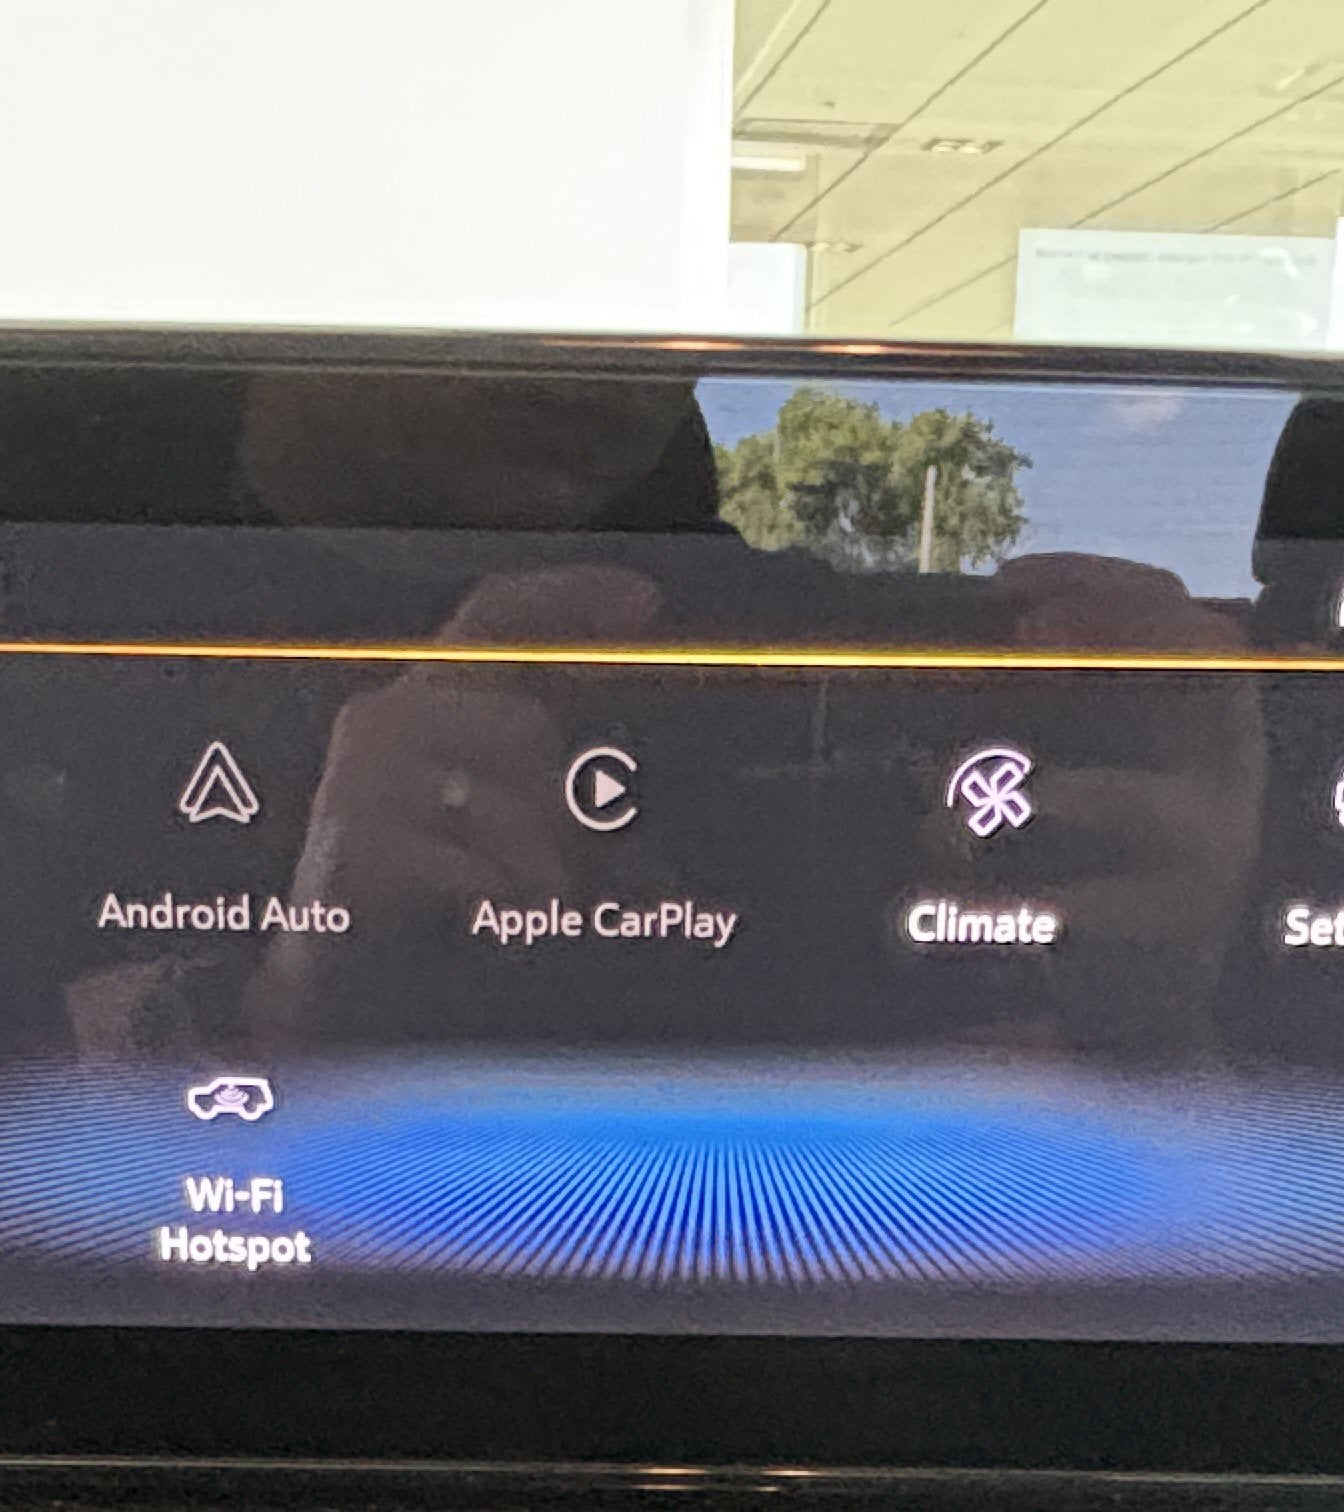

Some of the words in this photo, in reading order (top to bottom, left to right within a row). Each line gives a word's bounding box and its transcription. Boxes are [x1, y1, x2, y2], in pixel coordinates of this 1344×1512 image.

[97, 893, 250, 933] Android
[261, 896, 351, 935] Auto
[471, 900, 583, 944] Apple
[592, 901, 738, 950] CarPlay
[907, 903, 1057, 944] Climate
[186, 1177, 284, 1214] Wi-Fi
[159, 1227, 312, 1271] Hotspot
